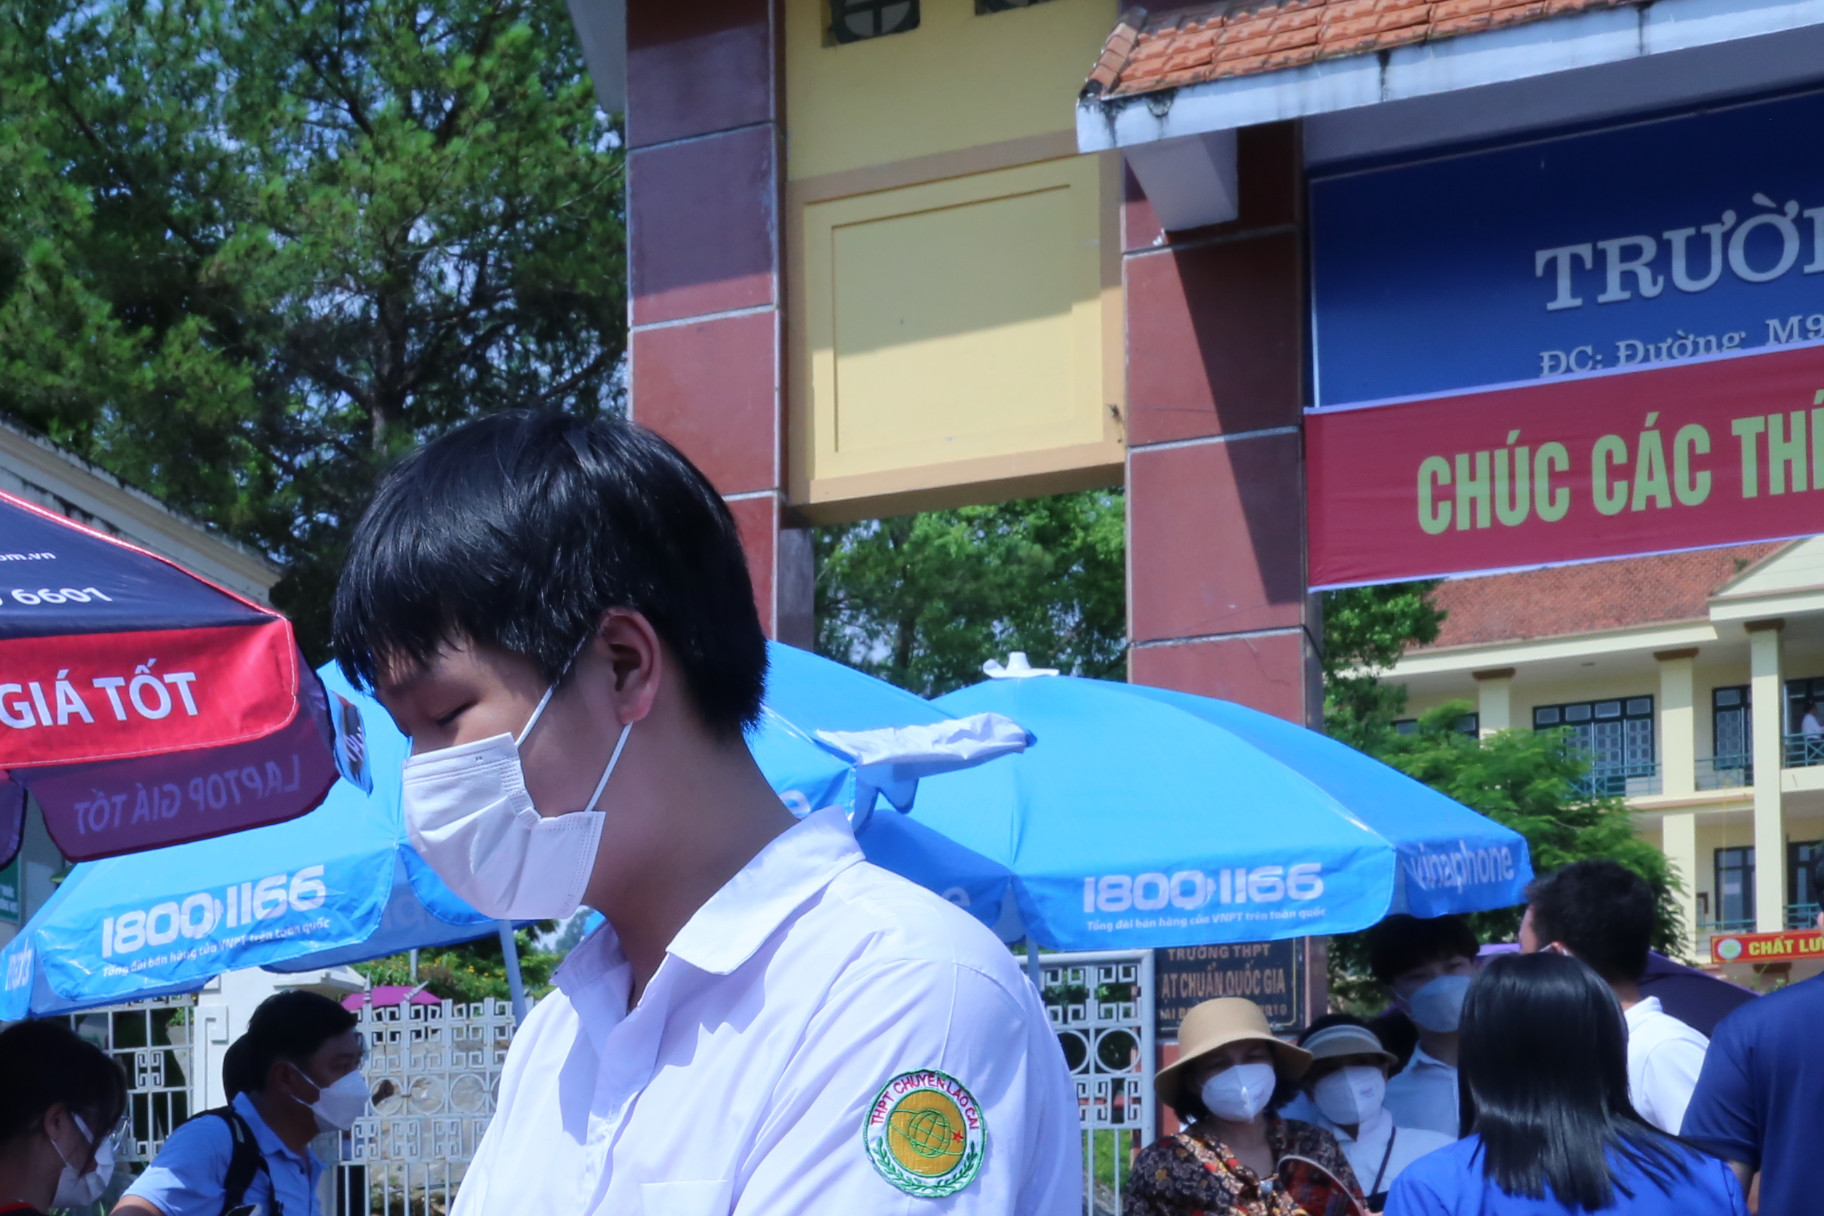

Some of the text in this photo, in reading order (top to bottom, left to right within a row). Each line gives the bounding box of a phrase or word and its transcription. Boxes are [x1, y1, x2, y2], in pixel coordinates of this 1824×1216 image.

[1616, 330, 1746, 366] Đường
[1417, 430, 1571, 536] CHÚC
[1591, 412, 1713, 517] CÁC
[11, 586, 113, 605] 6601
[93, 657, 201, 720] TỐT
[1410, 839, 1515, 895] vinaphone
[1212, 911, 1243, 924] VNPT
[1299, 905, 1327, 919] quốc
[219, 935, 247, 951] VNPT
[1231, 943, 1272, 958] THPT
[1748, 935, 1795, 956] CHẤT
[1179, 961, 1223, 998] CHUẨN
[1226, 959, 1262, 996] QUỐC
[1263, 967, 1287, 995] GIA
[871, 1091, 894, 1125] THPT
